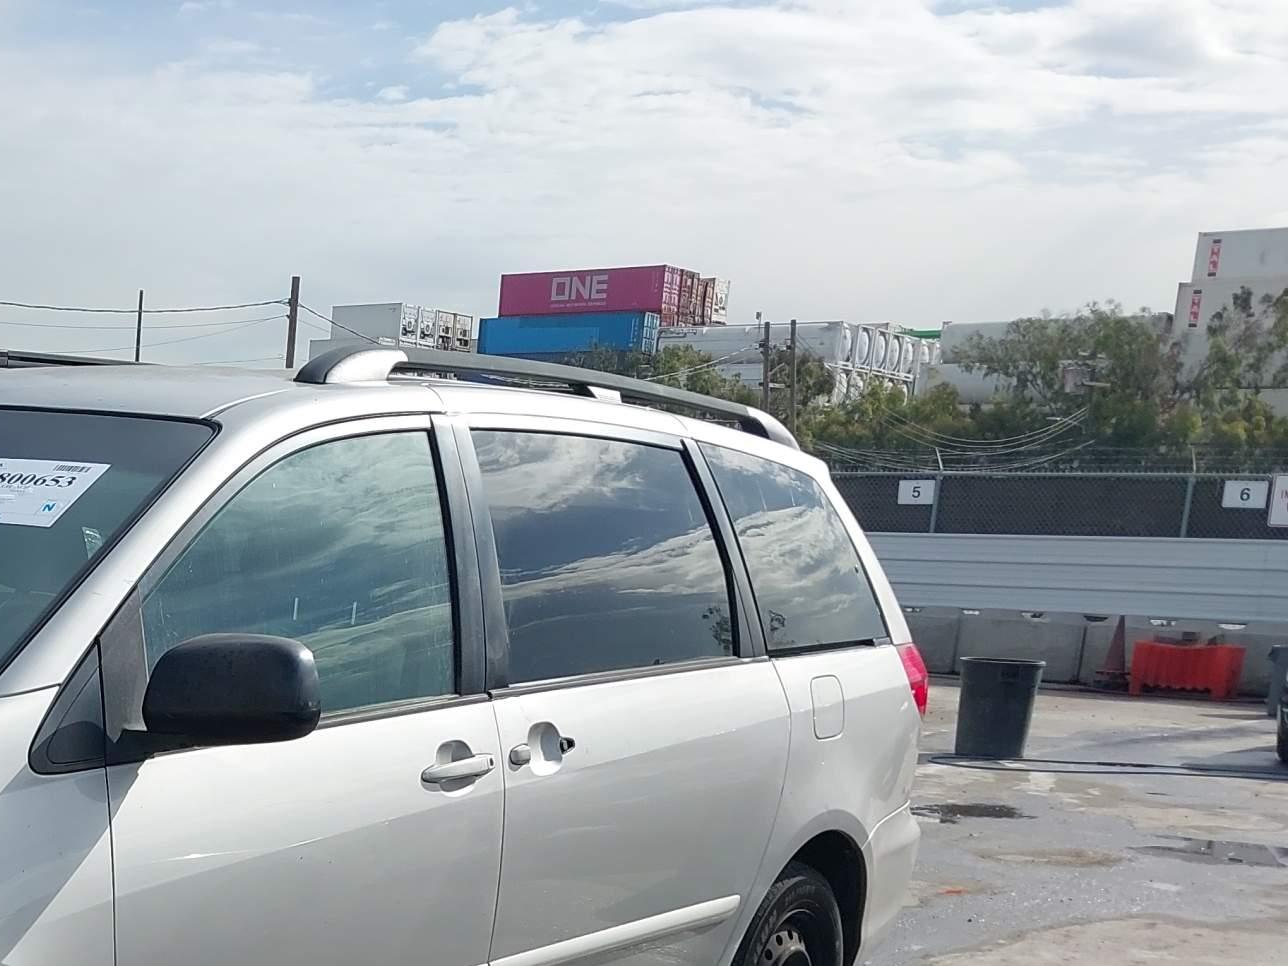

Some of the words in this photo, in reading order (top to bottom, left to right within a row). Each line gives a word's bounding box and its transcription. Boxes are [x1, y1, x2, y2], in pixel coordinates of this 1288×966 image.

[551, 275, 608, 300] ONE
[912, 486, 920, 498] 5
[1240, 488, 1250, 501] 6
